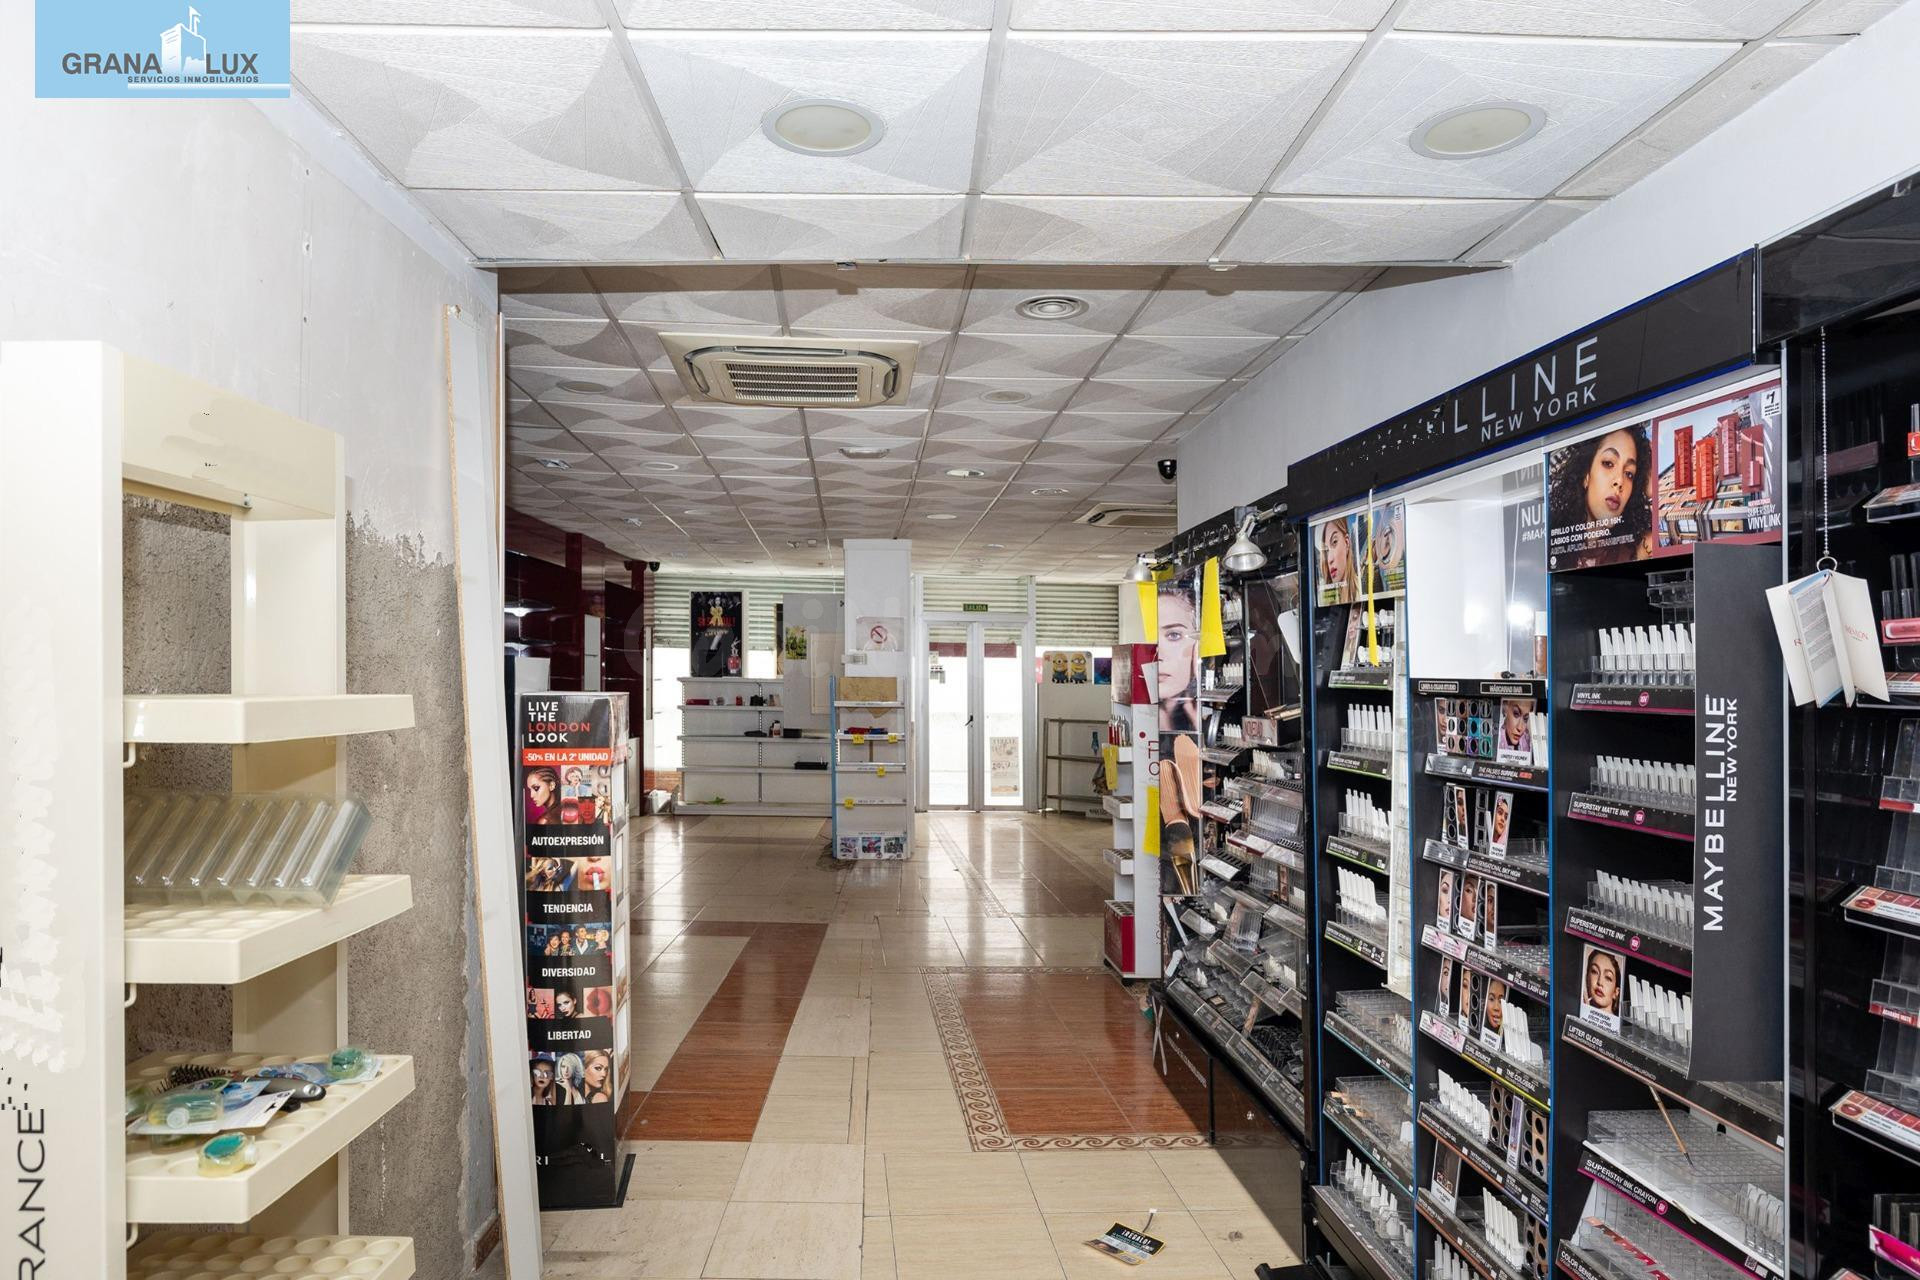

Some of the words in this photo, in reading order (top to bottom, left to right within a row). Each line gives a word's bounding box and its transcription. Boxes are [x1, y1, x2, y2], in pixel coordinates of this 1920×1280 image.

[1442, 336, 1599, 434] LLINE
[1481, 412, 1524, 442] NEW
[1533, 383, 1597, 422] YORK
[1521, 503, 1546, 528] NU
[1747, 515, 1768, 530] VINYL
[1768, 513, 1781, 527] INK
[1551, 526, 1570, 536] BRILLO
[1575, 521, 1595, 532] COLOR
[1596, 518, 1609, 527] FIJO
[1550, 537, 1569, 546] LABIOS
[1570, 534, 1583, 542] CON
[528, 701, 559, 711] LIVE
[528, 712, 556, 722] THE
[1726, 698, 1738, 753] YORK
[528, 722, 591, 732] LONDON
[528, 732, 568, 743] LOOK
[525, 753, 543, 761] -50%
[544, 753, 557, 761] EN
[557, 753, 567, 761] LA
[578, 752, 609, 761] UNIDAD
[1726, 757, 1738, 802] NEW
[1573, 801, 1601, 813] SUPERSTAY
[1600, 806, 1619, 816] MATTE
[1619, 809, 1630, 817] INK
[1703, 696, 1726, 931] MAYBELLINE
[532, 834, 604, 847] AUTOEXPRESIÓN
[543, 903, 594, 914] TENDENCIA
[1570, 916, 1599, 931] SUPERSTAY
[1598, 926, 1614, 937] MATTE
[1614, 931, 1626, 941] INK
[542, 966, 596, 977] DIVERSIDAD
[547, 1030, 592, 1041] LIBERTAD
[1568, 1025, 1586, 1038] LIFTER
[1585, 1031, 1603, 1047] GLOSS
[1586, 1159, 1623, 1184] SUPERSTAY
[1623, 1180, 1633, 1190] INK
[1633, 1186, 1658, 1205] CRAYON
[1561, 1251, 1579, 1269] COLOR
